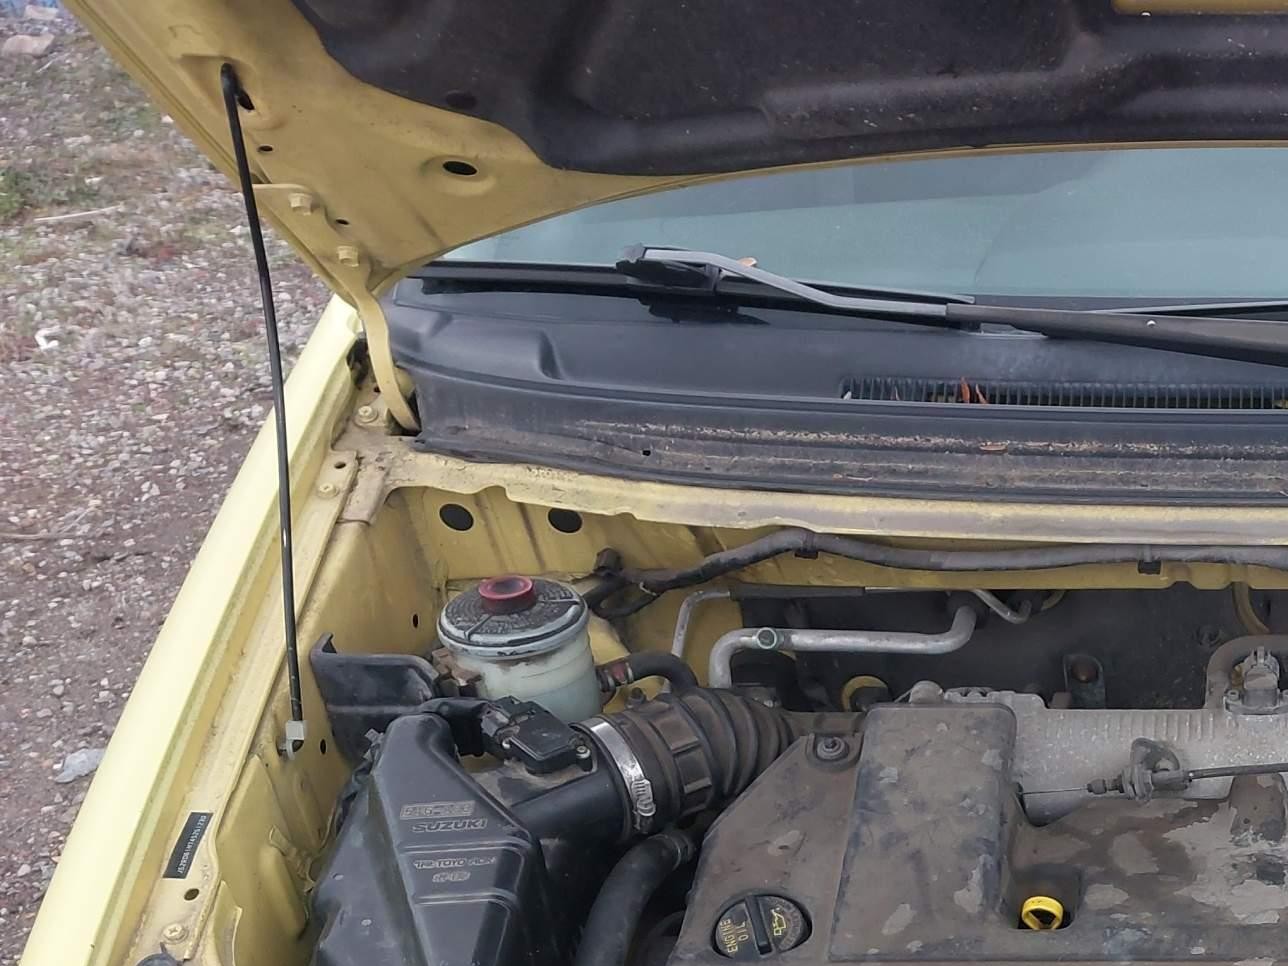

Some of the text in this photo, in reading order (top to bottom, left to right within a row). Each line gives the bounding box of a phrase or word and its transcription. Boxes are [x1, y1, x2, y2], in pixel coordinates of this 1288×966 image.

[411, 818, 488, 833] SUZUKI
[719, 918, 739, 953] ENGINE
[737, 920, 750, 942] OIL
